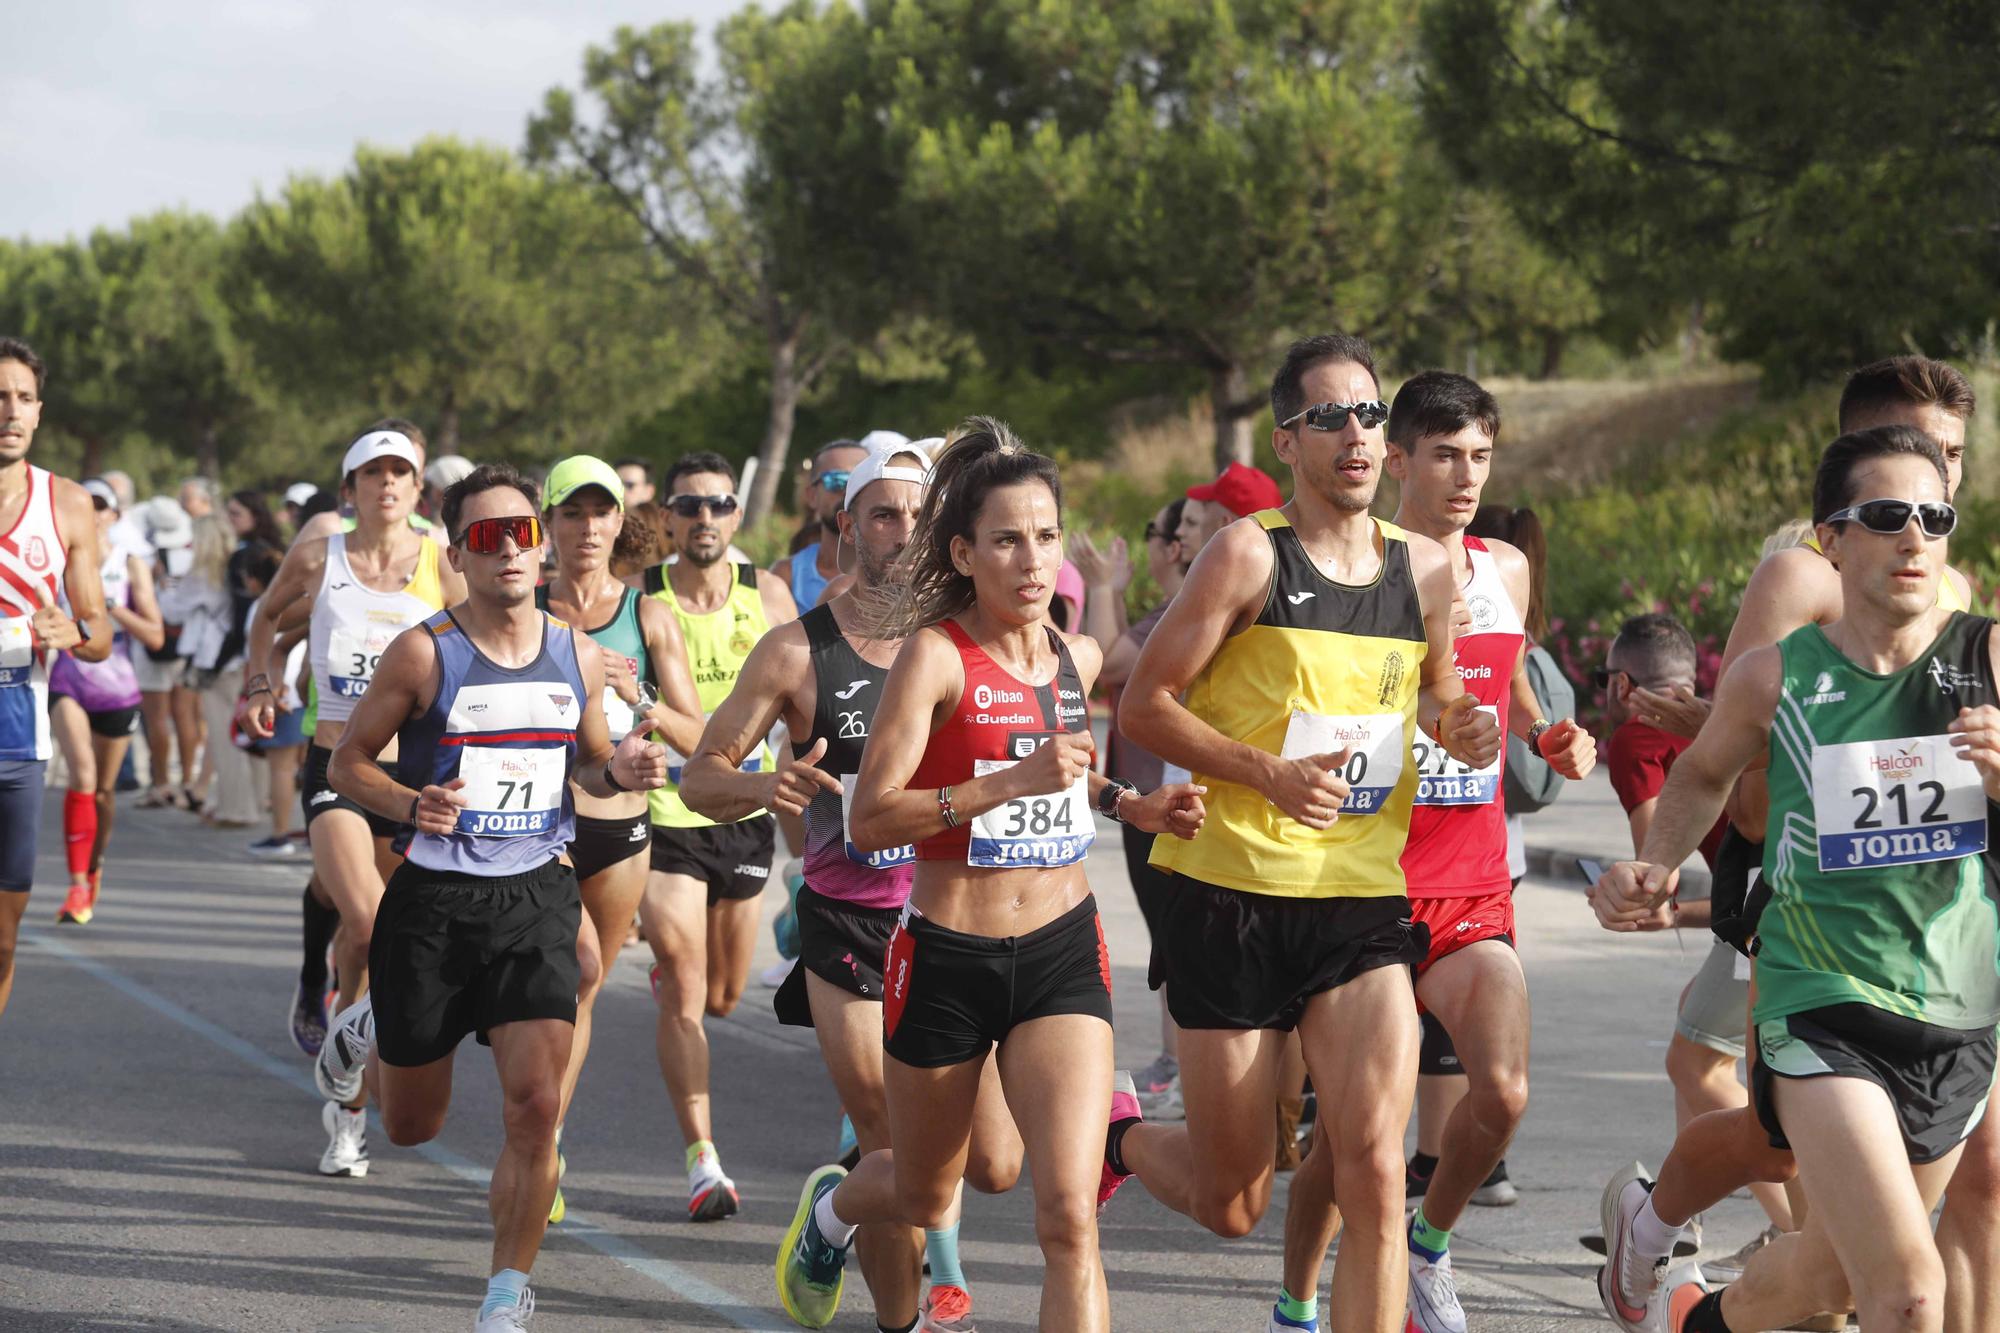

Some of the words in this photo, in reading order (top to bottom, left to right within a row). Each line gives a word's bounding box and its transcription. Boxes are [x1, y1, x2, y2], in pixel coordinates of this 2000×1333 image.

[696, 669, 741, 684] BAÑEZ
[1456, 664, 1491, 680] Soria
[975, 685, 1023, 709] Bilbao
[1803, 691, 1846, 706] VIATOR
[838, 711, 867, 739] 26
[976, 713, 1034, 724] Guedan
[497, 780, 533, 810] 71
[1852, 780, 1949, 829] 212
[1004, 797, 1073, 837] 384
